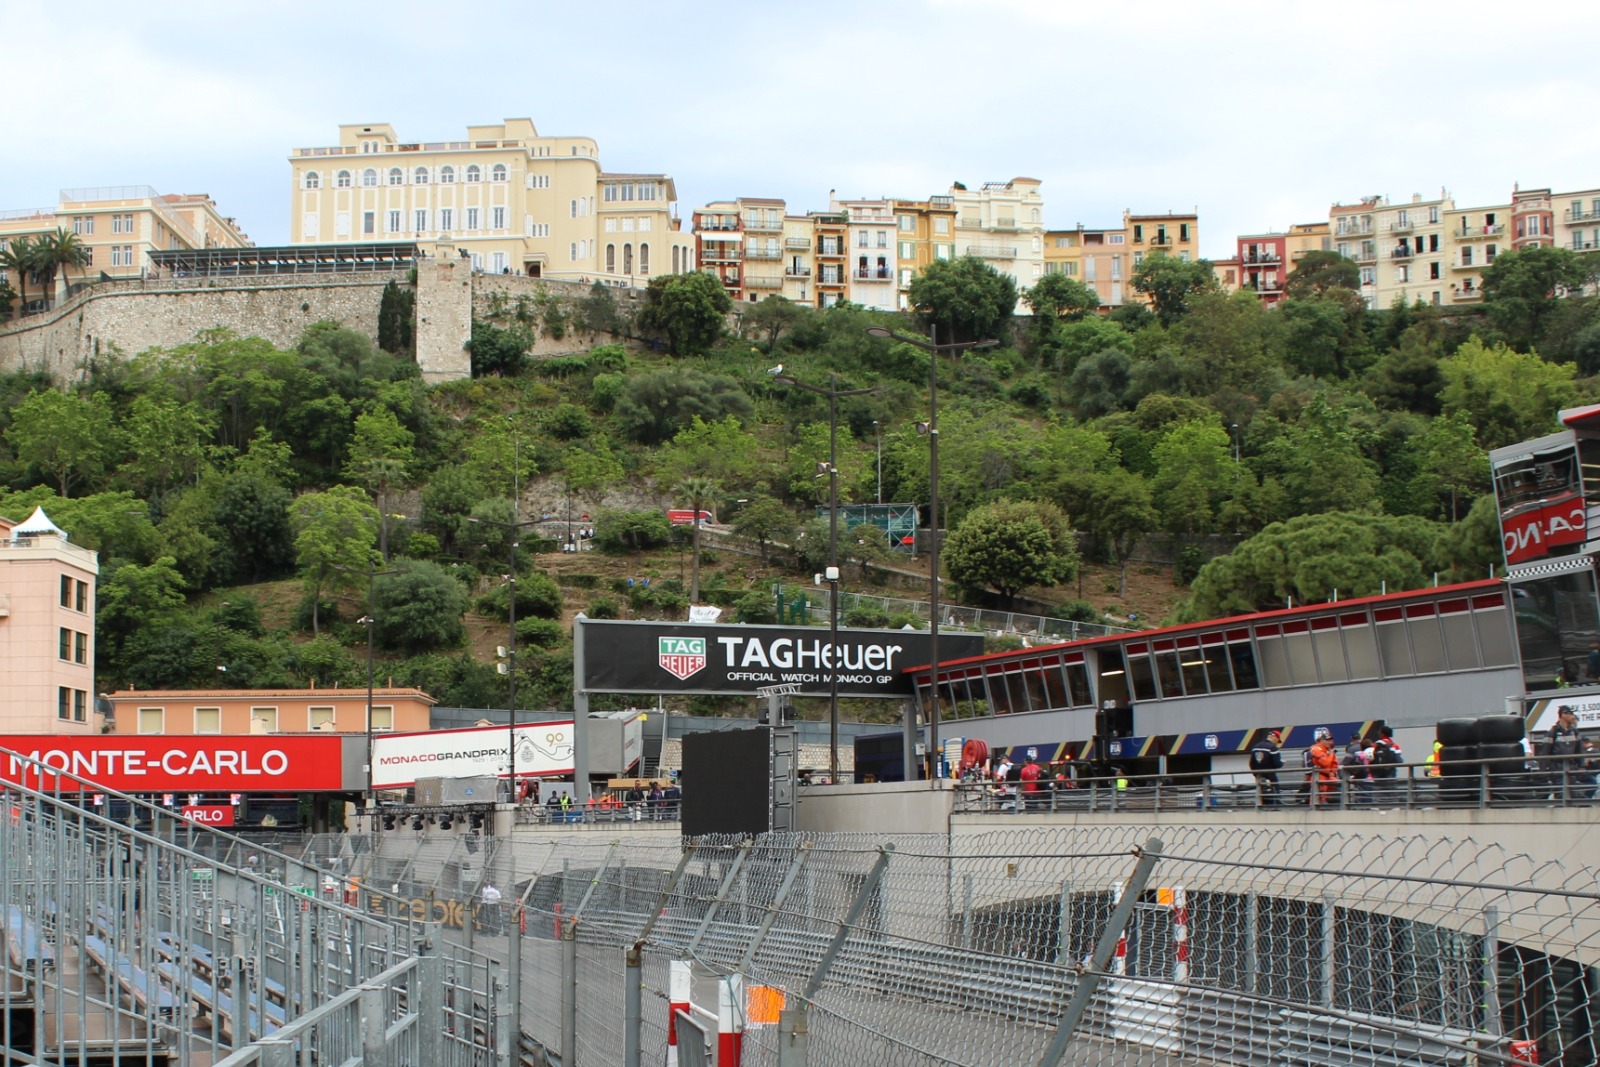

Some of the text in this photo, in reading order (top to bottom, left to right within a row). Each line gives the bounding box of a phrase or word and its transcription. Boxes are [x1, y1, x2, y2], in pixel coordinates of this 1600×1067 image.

[662, 640, 702, 653] TAG
[661, 656, 704, 676] HEUER
[727, 672, 777, 681] OFFICIAL
[781, 673, 819, 682] WATCH
[876, 674, 892, 684] GP
[546, 733, 564, 747] 90
[9, 750, 288, 776] MONTE-CARLO
